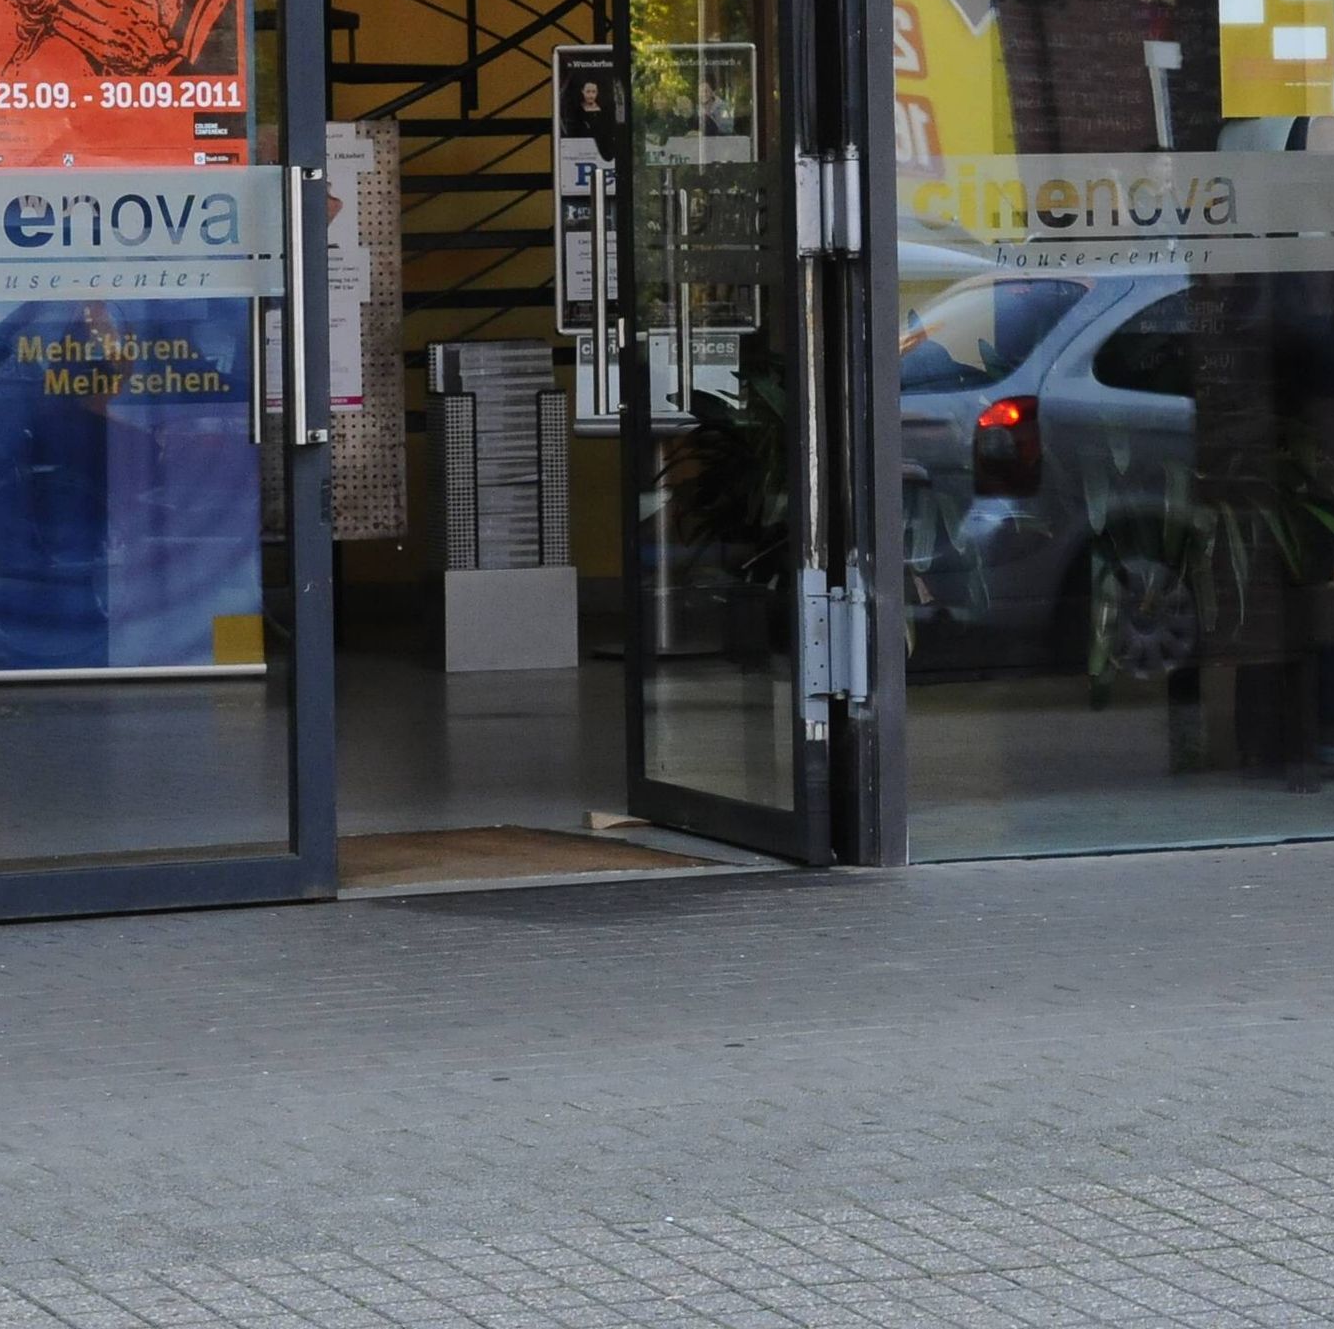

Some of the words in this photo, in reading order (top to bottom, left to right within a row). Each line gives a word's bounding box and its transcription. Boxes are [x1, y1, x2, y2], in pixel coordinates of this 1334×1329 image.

[100, 81, 242, 109] 30.09.2011
[914, 164, 1238, 231] cinenova
[17, 335, 95, 363] Mehr
[103, 335, 199, 362] hören.
[44, 369, 124, 396] Mehr
[129, 367, 230, 395] sehen.
